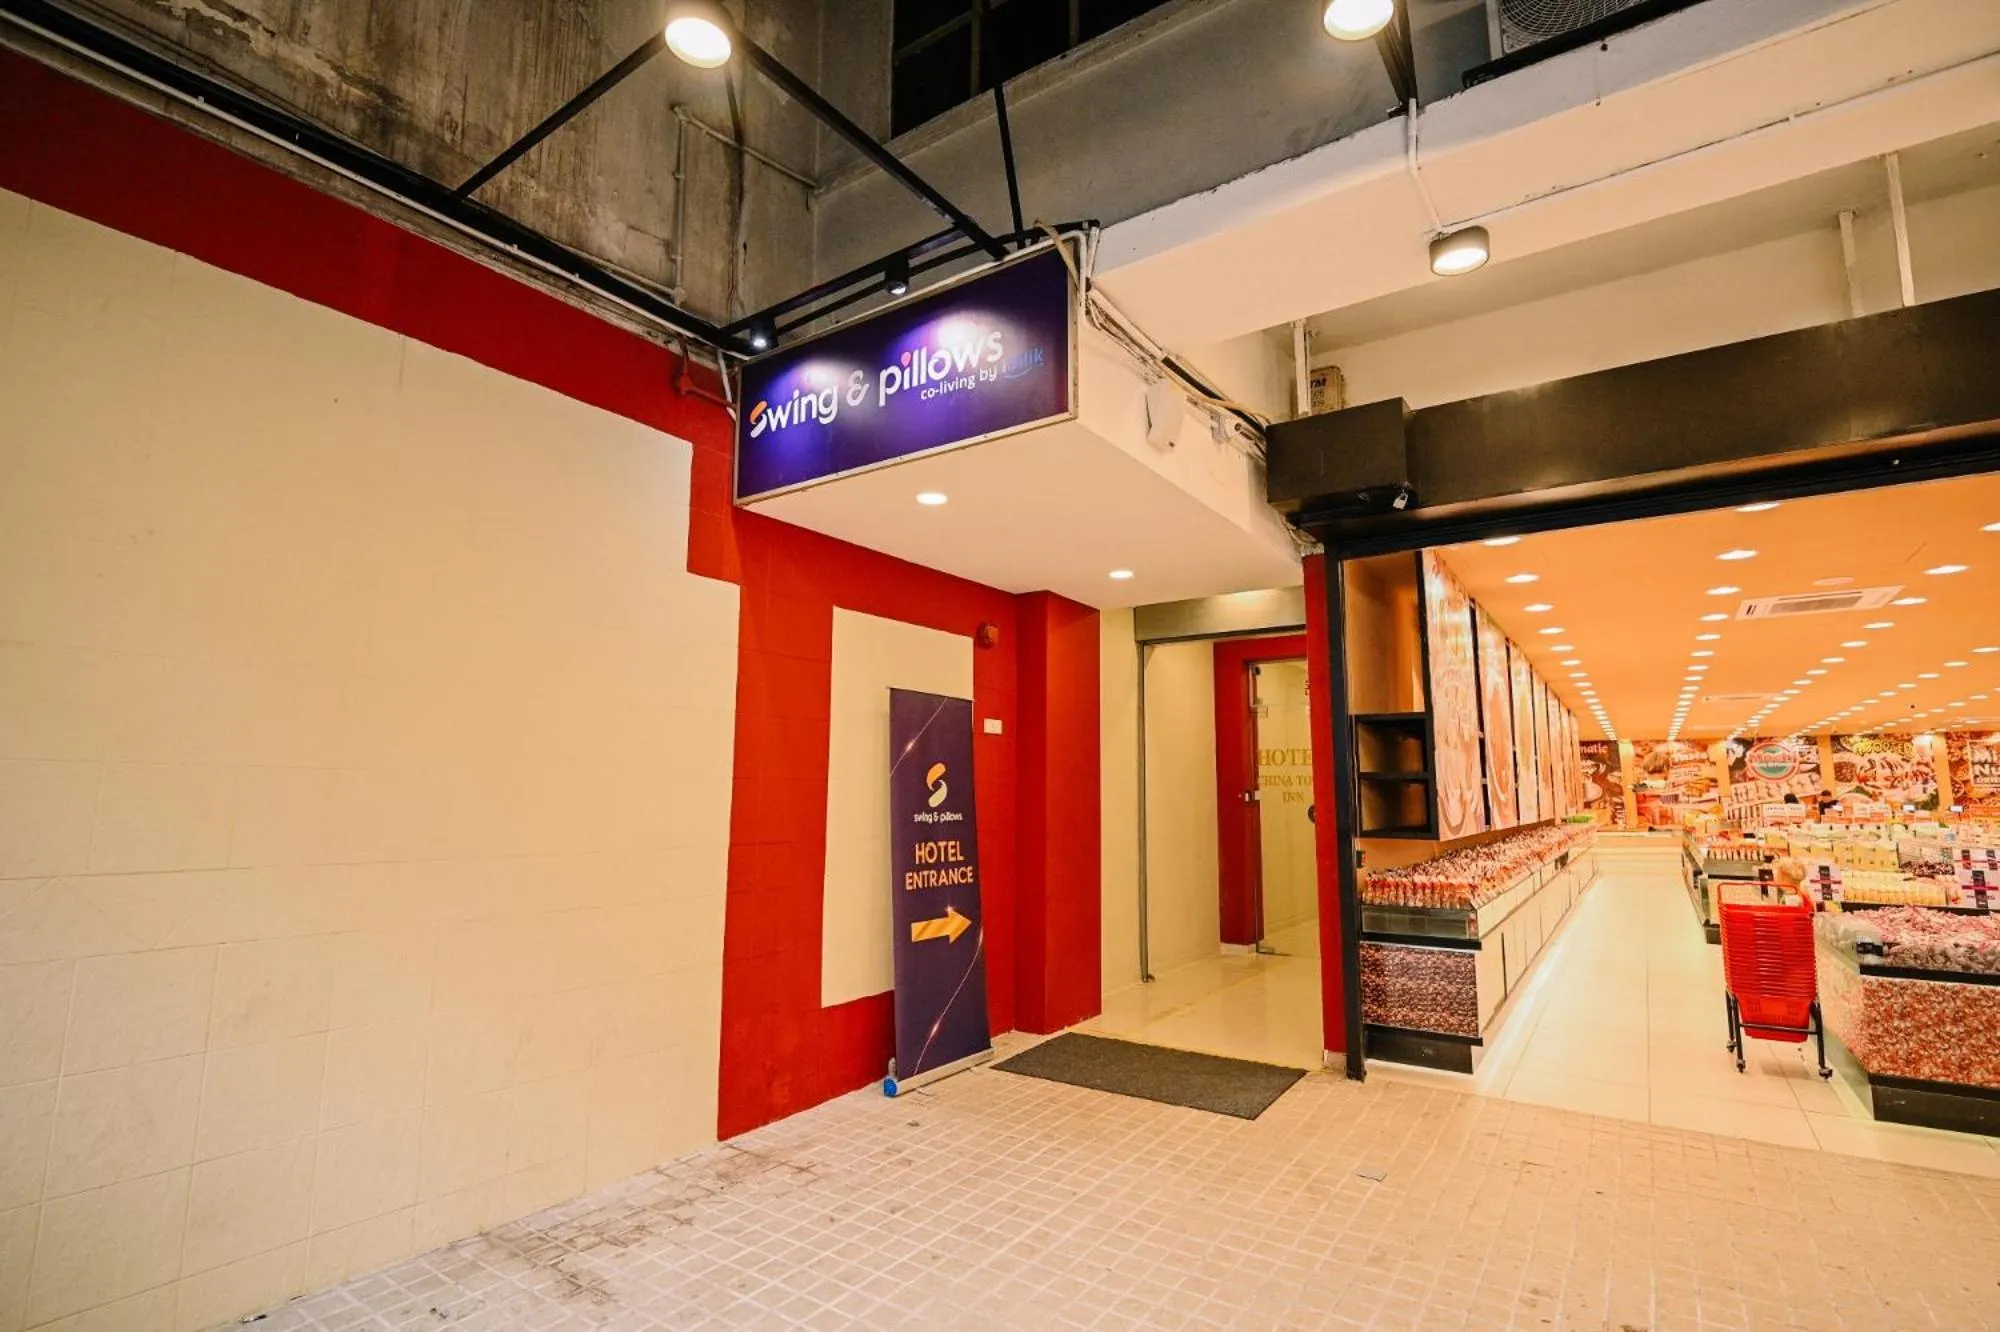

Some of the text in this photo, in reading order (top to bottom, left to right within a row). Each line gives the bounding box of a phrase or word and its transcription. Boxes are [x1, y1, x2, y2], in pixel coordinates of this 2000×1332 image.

[846, 370, 870, 407] &
[878, 331, 1004, 407] pillows
[920, 374, 977, 400] co-living
[979, 365, 998, 383] by
[1257, 749, 1313, 766] HOTE
[1282, 791, 1305, 803] INN
[914, 811, 933, 824] swing
[933, 811, 939, 822] &
[915, 840, 965, 865] HOTEL
[905, 866, 974, 890] ENTRANCE
